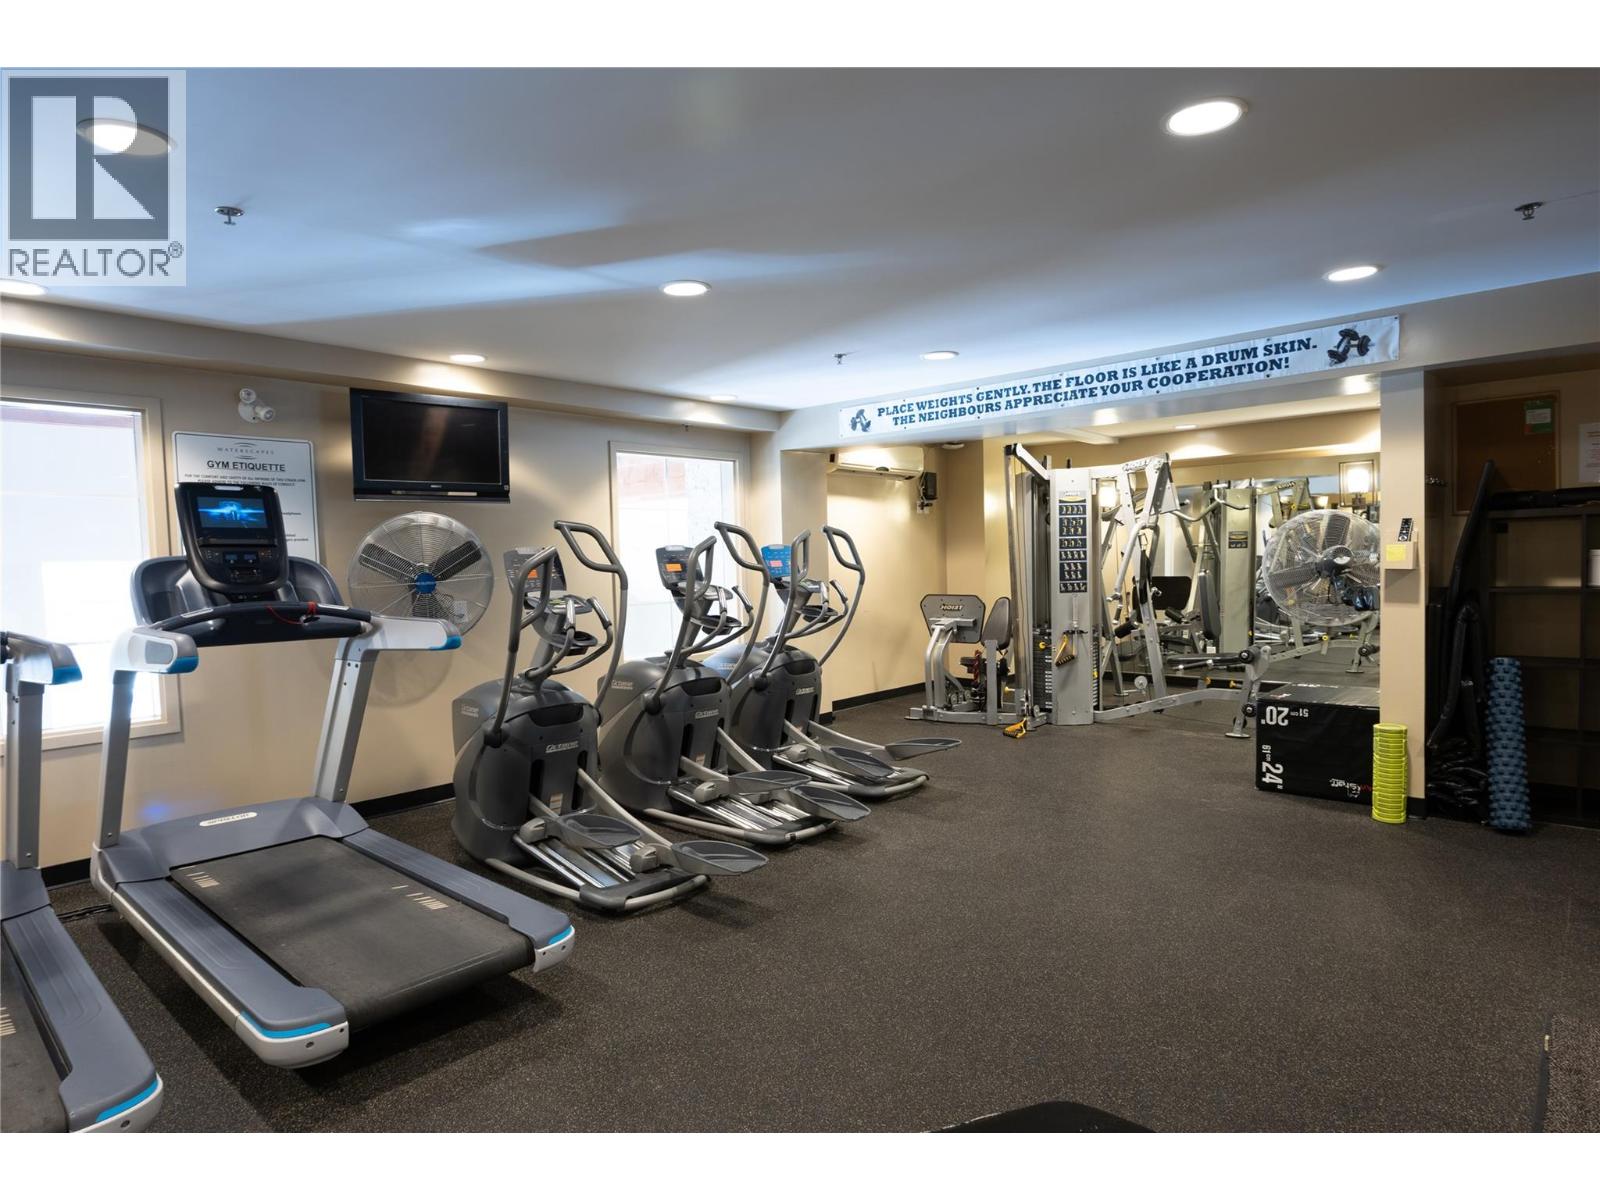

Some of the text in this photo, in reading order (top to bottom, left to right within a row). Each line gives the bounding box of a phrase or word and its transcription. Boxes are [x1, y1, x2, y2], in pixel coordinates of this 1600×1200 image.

[877, 337, 1318, 417] PLACE WEIGHTS GENTLY. THE FLOOR IS LIKE A DRUM SKIN.
[892, 357, 1290, 426] THE NEIGHBOURS APPRECIATE YOUR COOPERATION!
[207, 460, 286, 472] GYM ETIQUETTE
